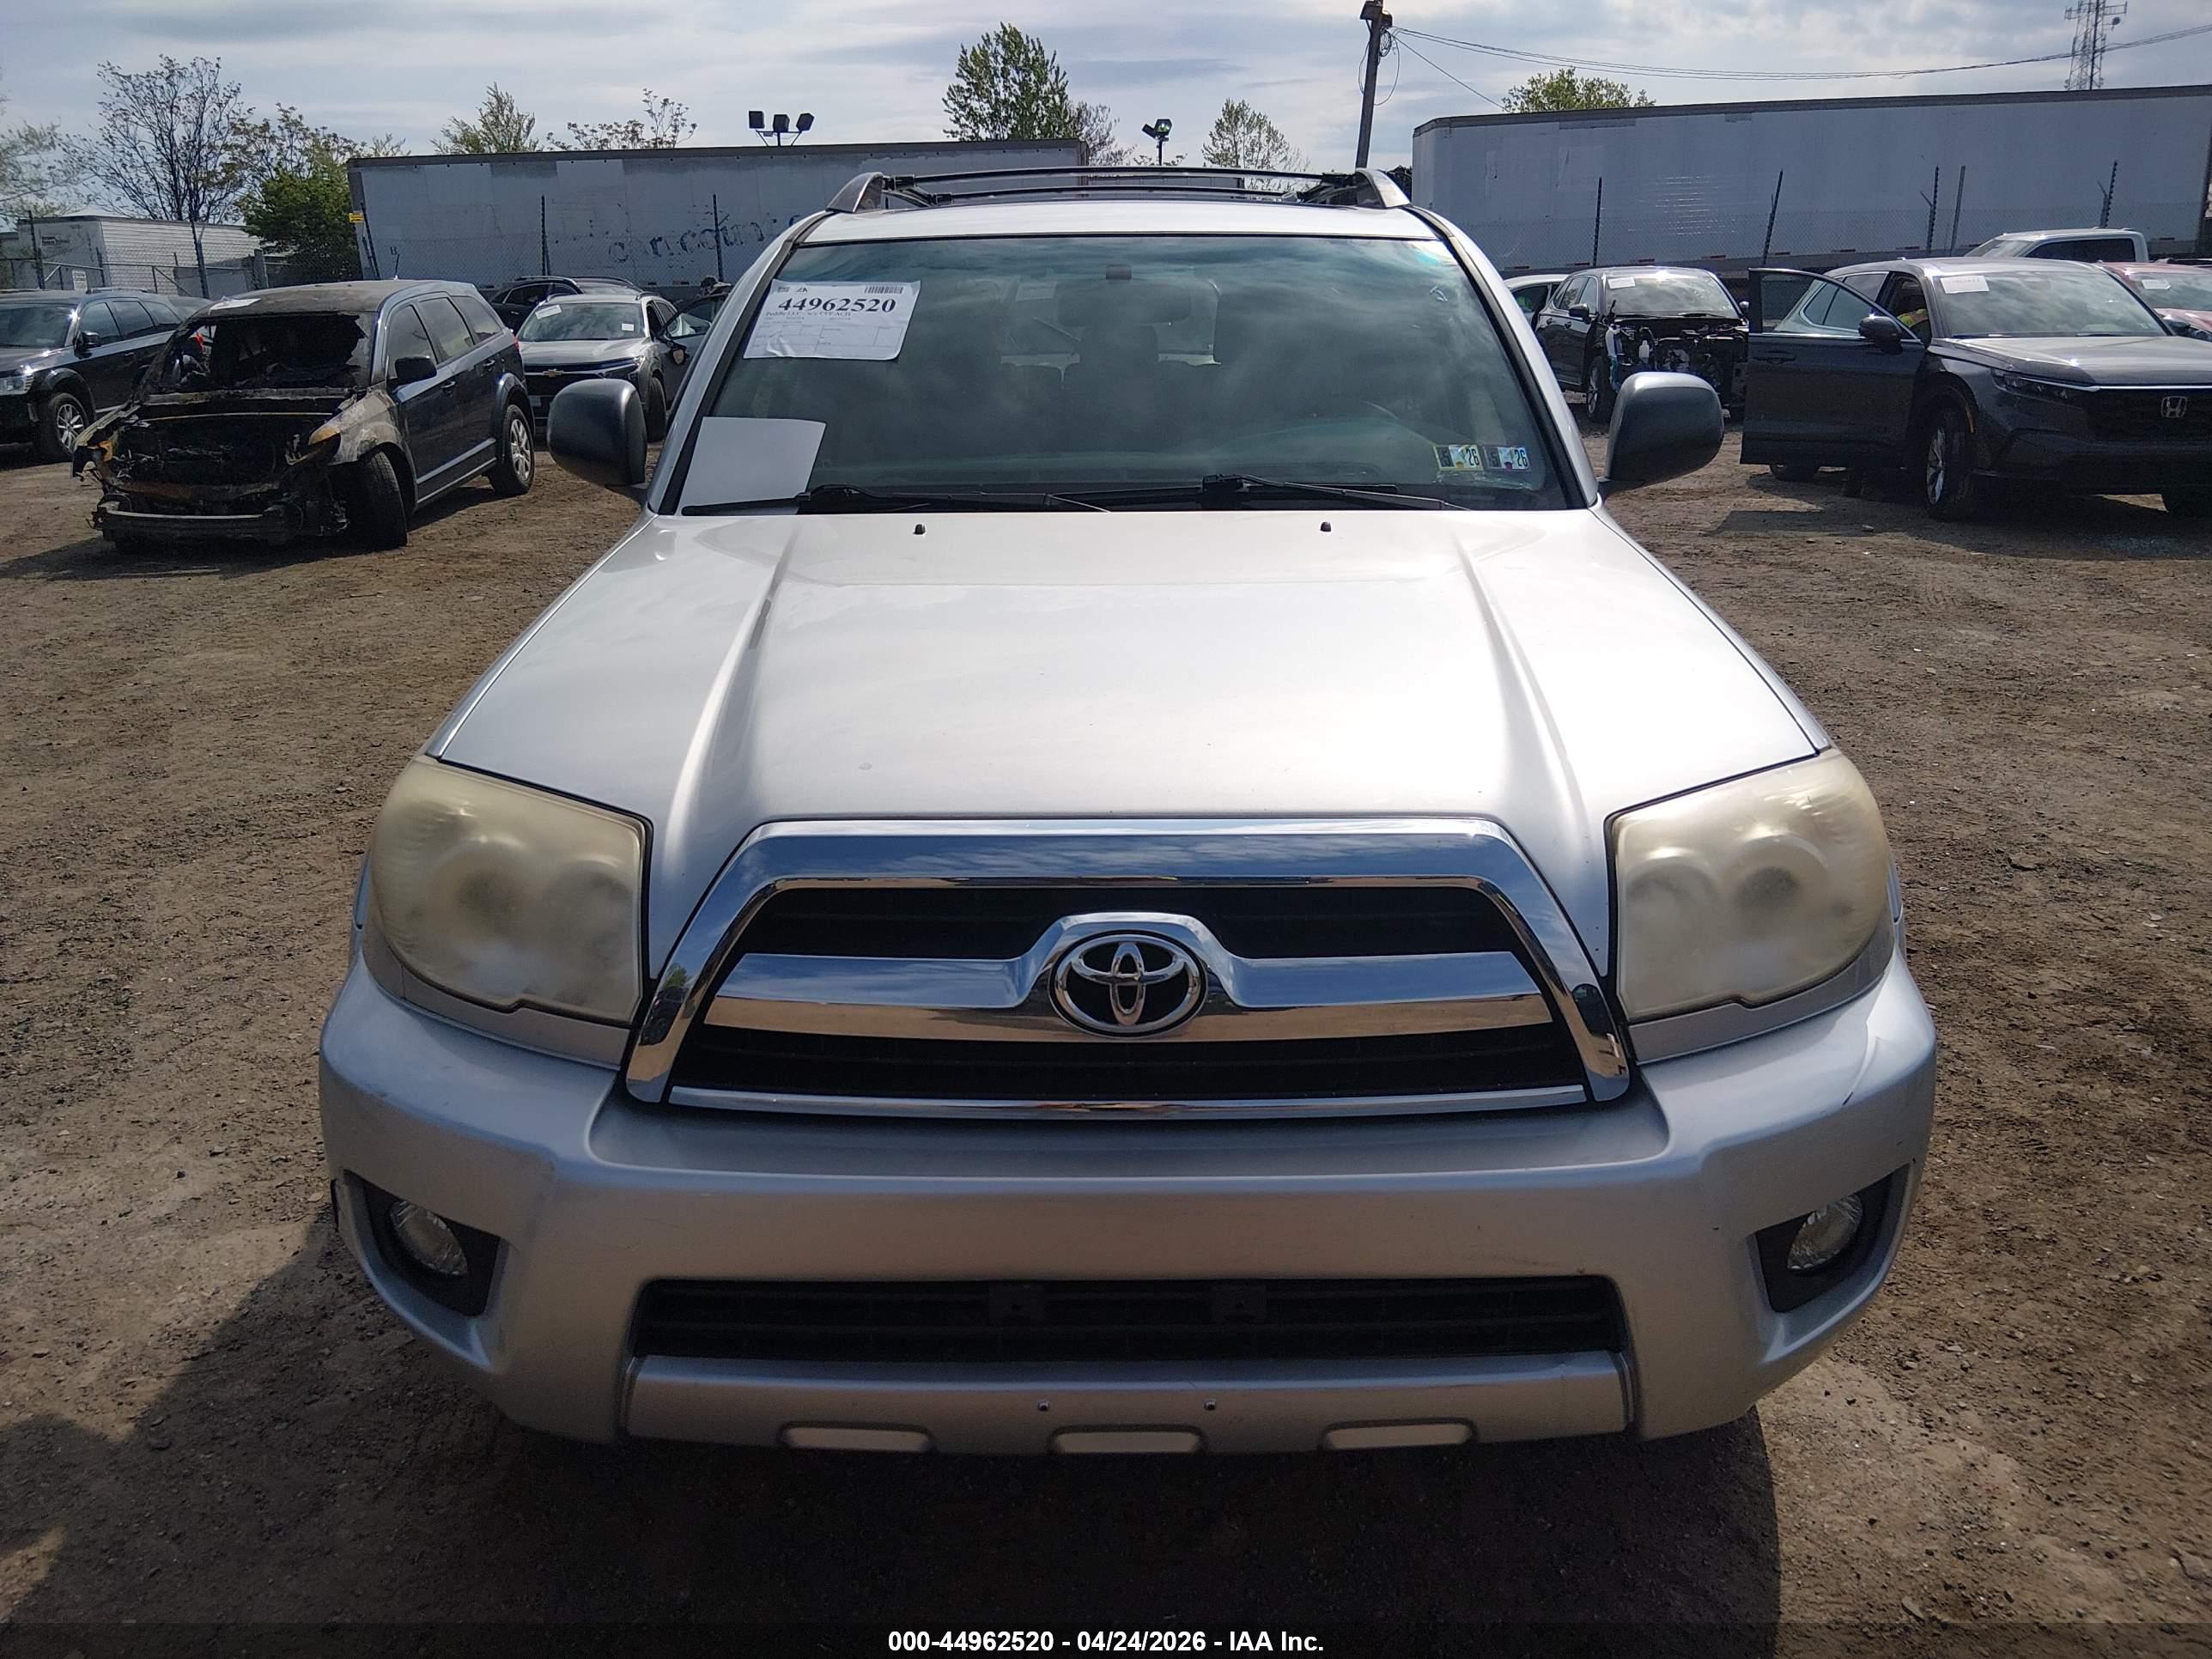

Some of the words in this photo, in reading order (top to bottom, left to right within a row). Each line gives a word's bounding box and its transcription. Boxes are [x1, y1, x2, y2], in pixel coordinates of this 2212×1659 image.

[778, 297, 896, 313] 44962520
[1466, 448, 1480, 466] 26
[1514, 449, 1528, 467] 26
